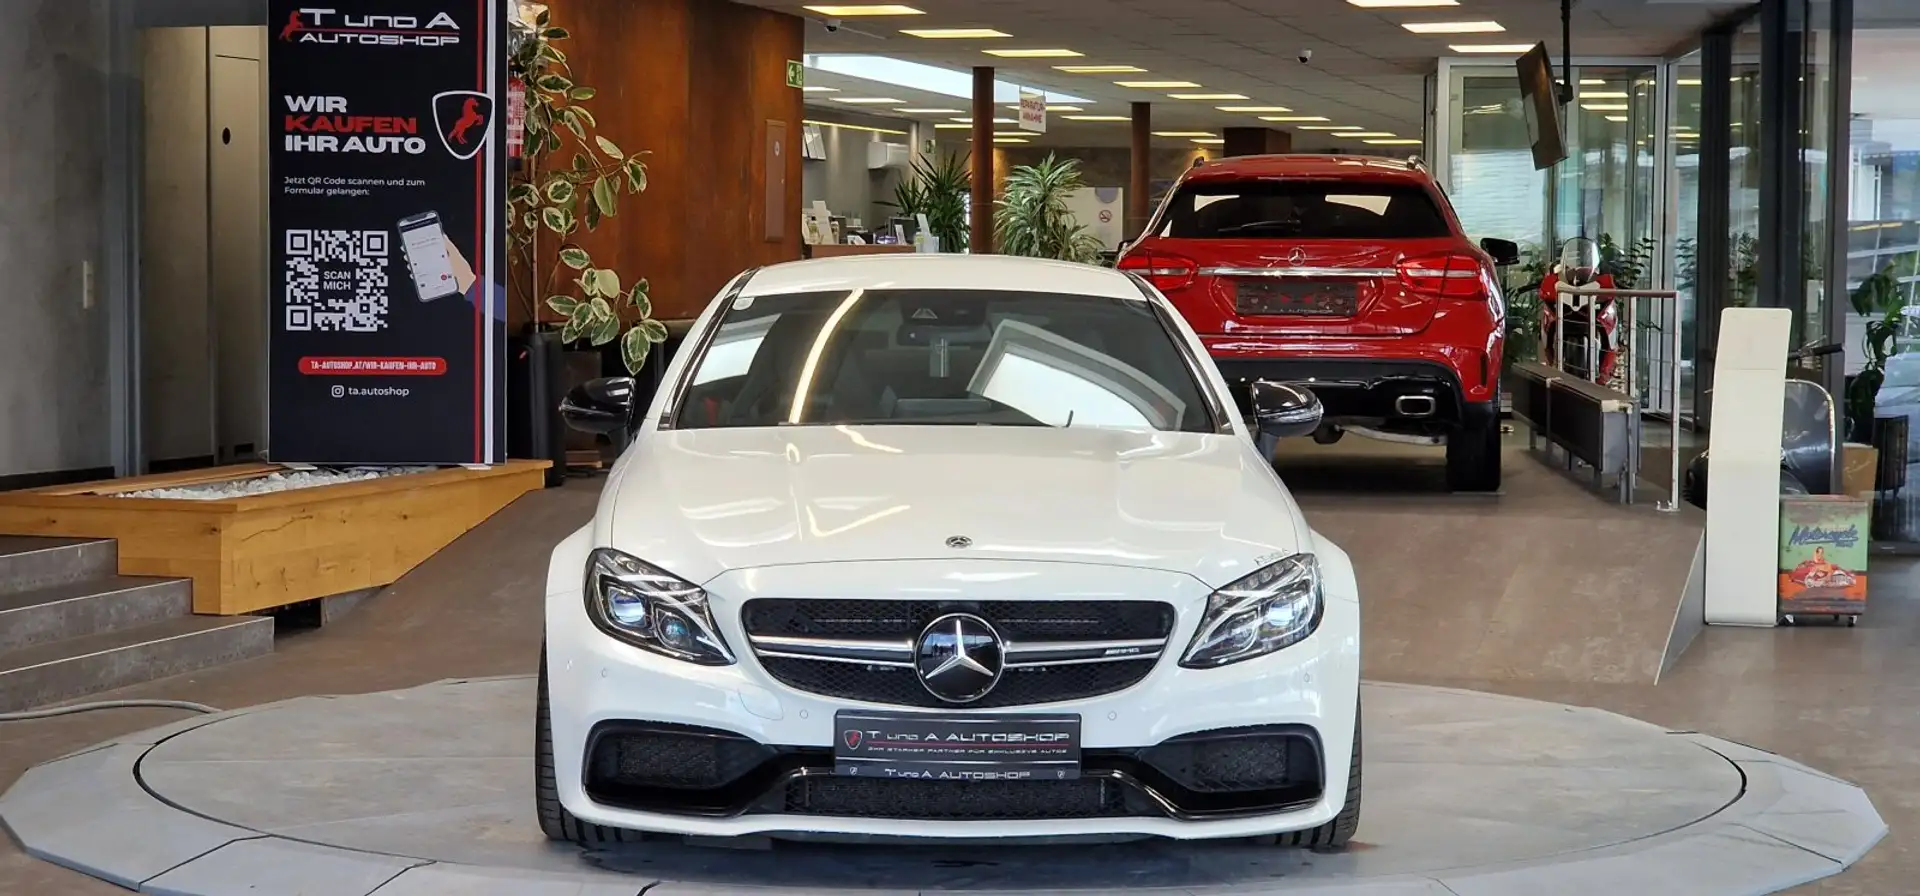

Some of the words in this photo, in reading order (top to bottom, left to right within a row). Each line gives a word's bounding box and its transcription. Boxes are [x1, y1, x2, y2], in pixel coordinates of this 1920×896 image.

[299, 8, 336, 26] T
[424, 11, 460, 30] A
[299, 32, 460, 47] AUTOSHOP
[284, 95, 348, 113] WIR
[285, 115, 417, 134] KAUFEN
[285, 134, 339, 153] IHR
[341, 136, 427, 154] AUTO
[284, 176, 306, 185] Jetzt
[307, 176, 322, 186] QR
[322, 176, 346, 185] Code
[347, 178, 385, 186] scannen
[386, 178, 405, 186] und
[284, 186, 325, 195] Formular
[326, 187, 371, 197] gelangen:
[323, 270, 351, 280] SCAN
[323, 281, 351, 291] MICH
[347, 386, 410, 397] ta.autoshop
[866, 730, 881, 739] T
[924, 732, 939, 741] A
[945, 733, 1070, 742] AUTOSHOP
[884, 768, 897, 777] T
[922, 770, 933, 779] A
[938, 771, 1031, 780] AUTOSHOP
